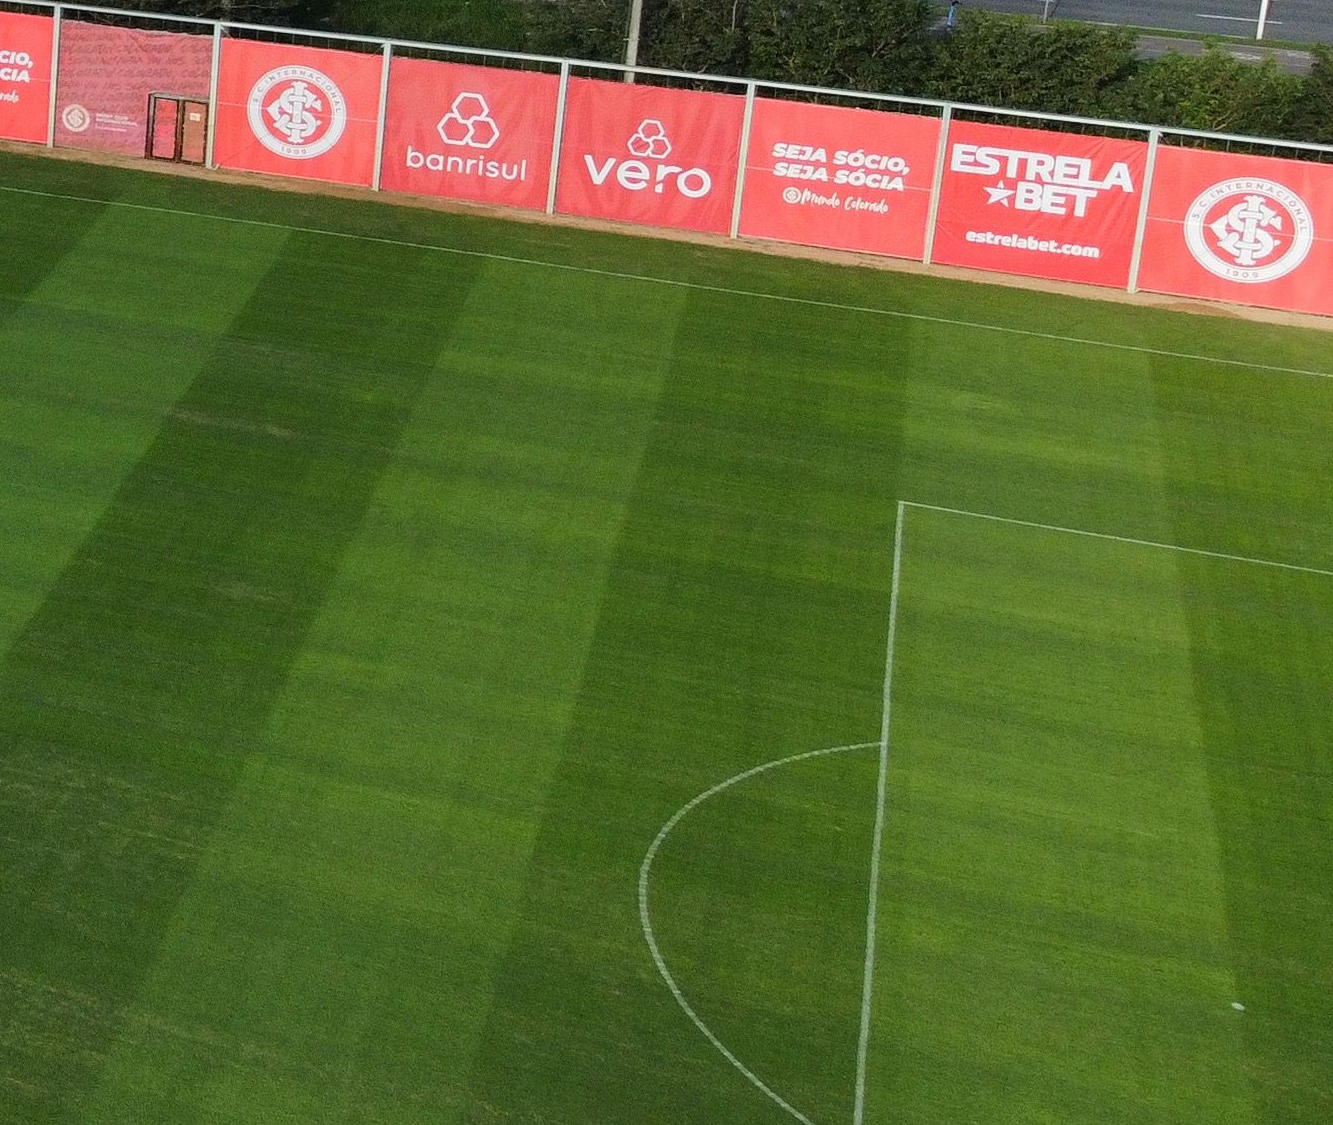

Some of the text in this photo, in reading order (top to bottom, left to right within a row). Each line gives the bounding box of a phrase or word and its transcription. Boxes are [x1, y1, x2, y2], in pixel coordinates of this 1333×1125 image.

[406, 145, 527, 181] banrisul
[584, 154, 712, 198] vero
[772, 142, 910, 176] SEJA SÓCIO,
[773, 162, 904, 192] SEJA SÓCIA
[950, 142, 1134, 193] ESTRELA
[844, 195, 889, 214] Colorado
[1014, 181, 1098, 218] BET
[1209, 182, 1308, 231] INTERNACIONAL
[965, 229, 1100, 259] estrelabet.com
